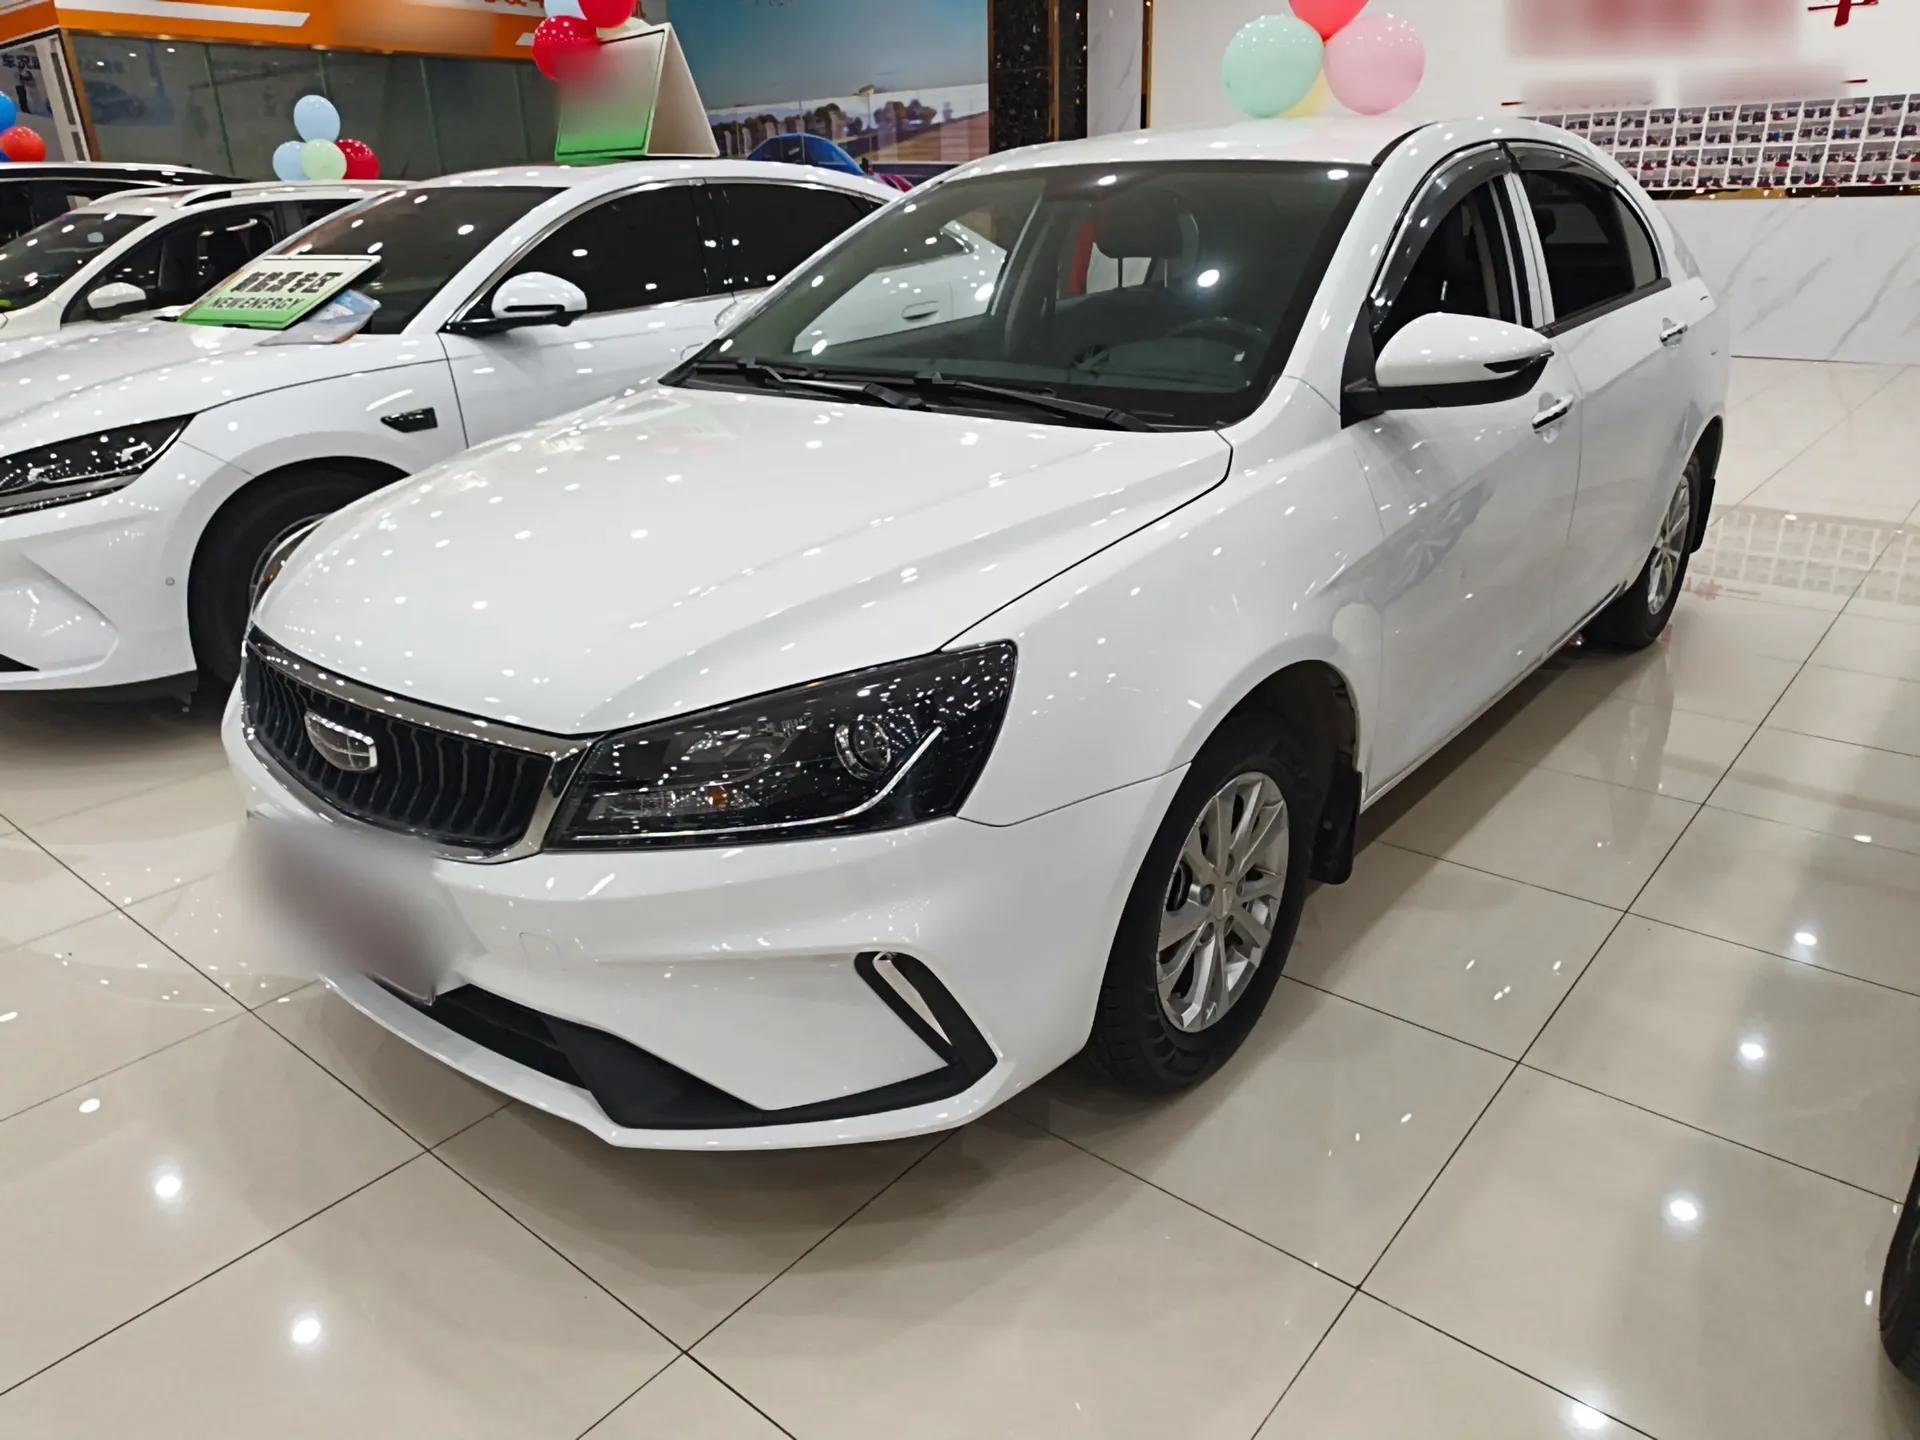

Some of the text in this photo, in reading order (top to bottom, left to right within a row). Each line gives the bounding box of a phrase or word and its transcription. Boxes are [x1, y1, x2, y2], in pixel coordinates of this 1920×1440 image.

[231, 272, 343, 293] 新能源专区
[208, 297, 304, 309] NEW ENERGY
